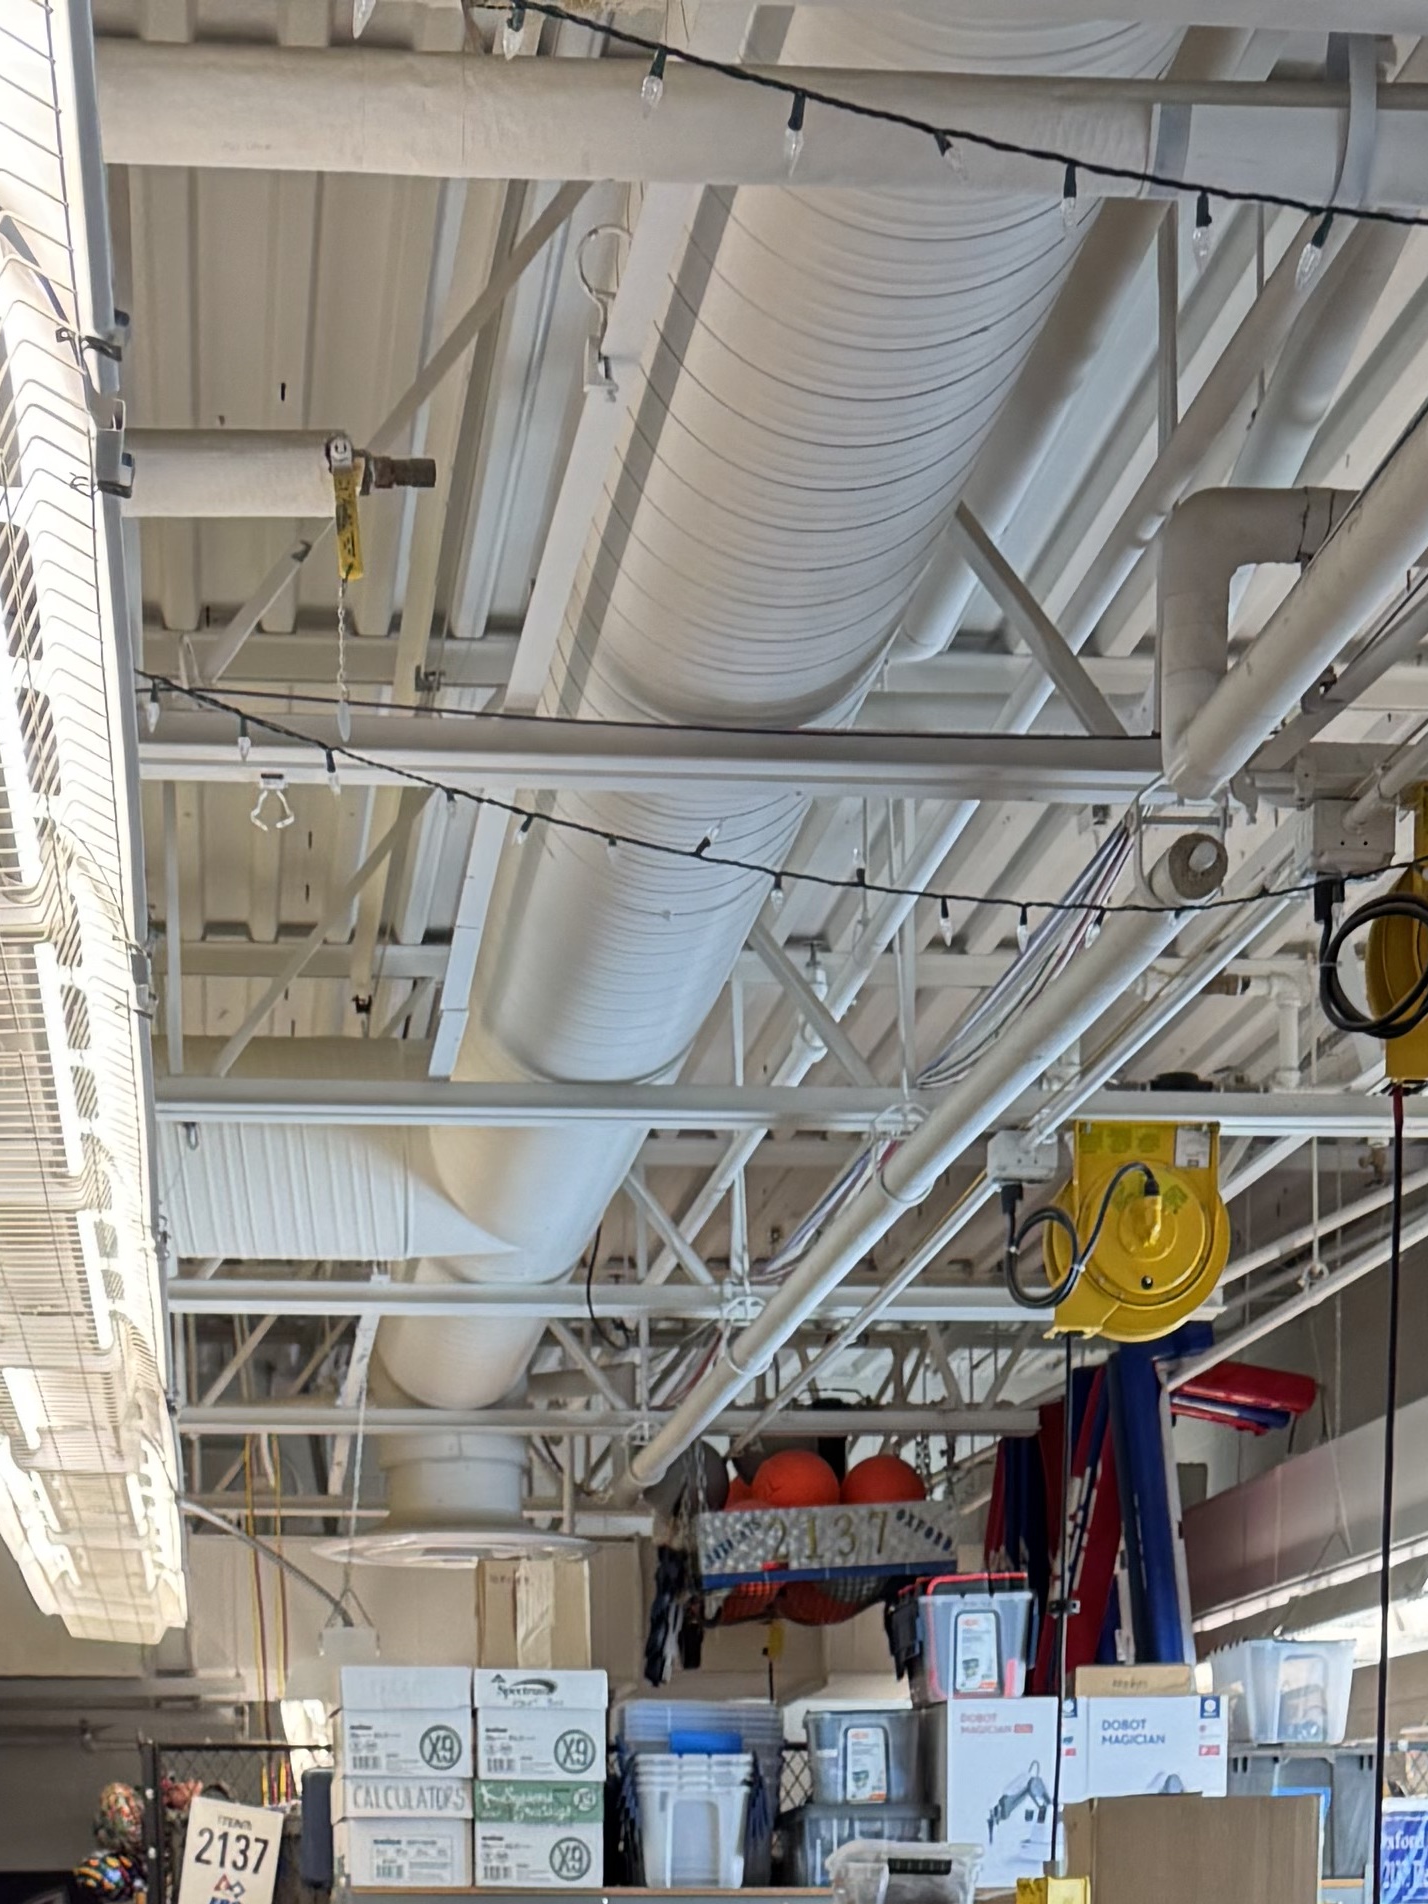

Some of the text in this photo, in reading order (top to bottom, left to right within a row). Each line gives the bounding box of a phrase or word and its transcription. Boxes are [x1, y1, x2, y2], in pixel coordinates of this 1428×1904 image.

[769, 1508, 889, 1563] 2137
[895, 1508, 953, 1551] OXFORD
[1101, 1719, 1147, 1731] DOBOT
[1101, 1734, 1166, 1745] MAGICIAN
[428, 1733, 455, 1763] X9
[562, 1737, 589, 1766] X9
[352, 1784, 465, 1811] CALCULATORS
[194, 1827, 270, 1875] 2137
[558, 1844, 585, 1874] X9
